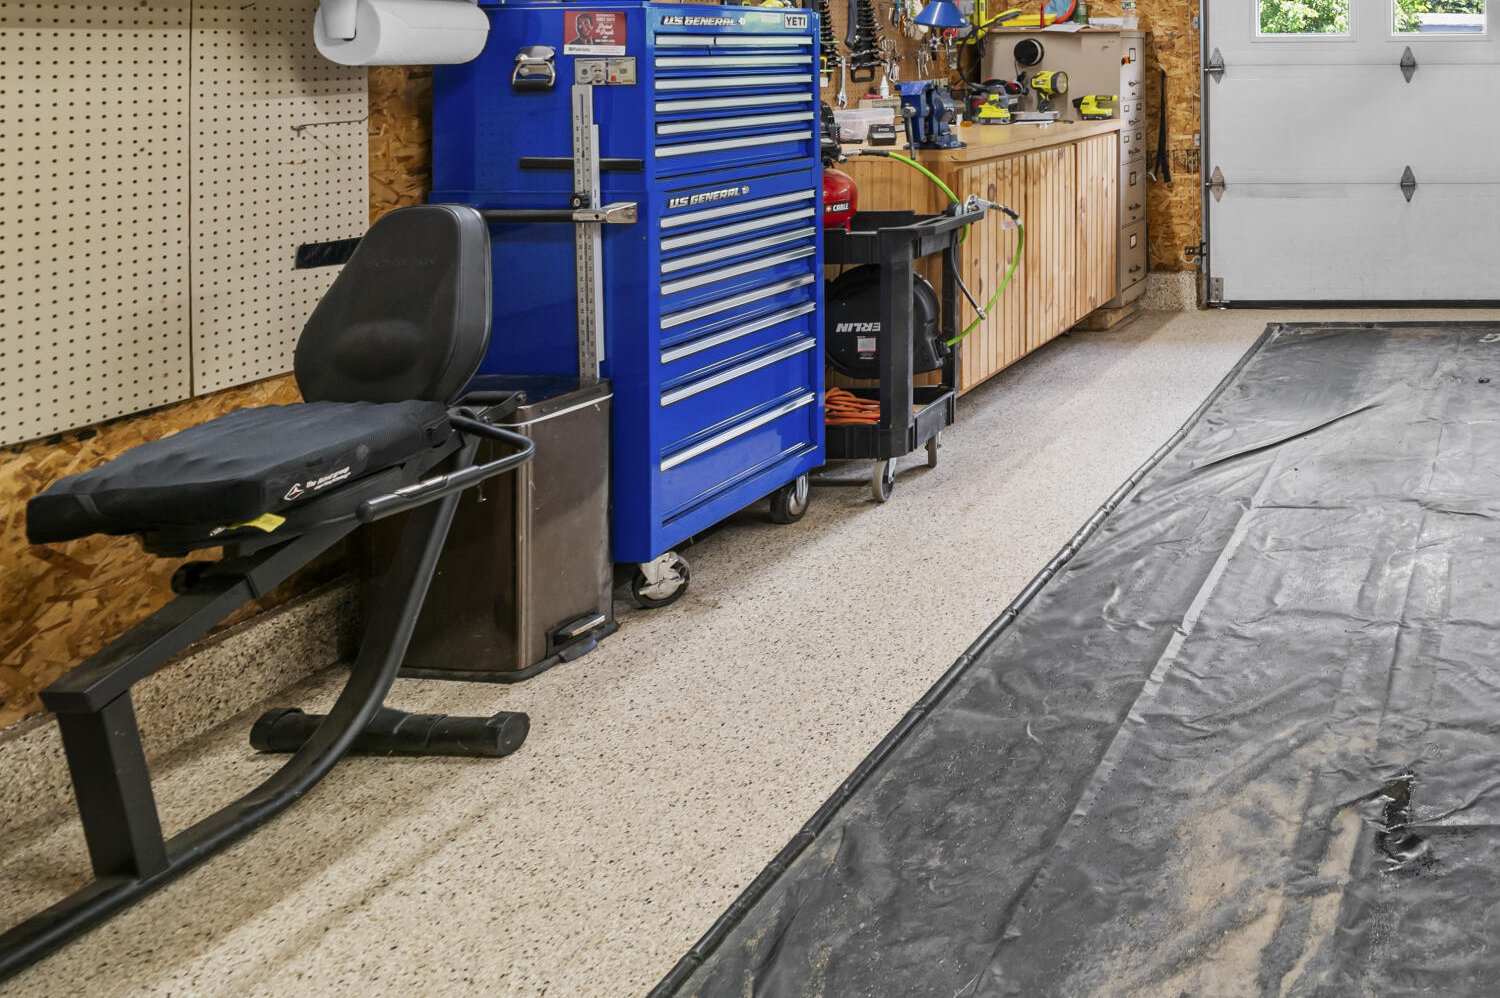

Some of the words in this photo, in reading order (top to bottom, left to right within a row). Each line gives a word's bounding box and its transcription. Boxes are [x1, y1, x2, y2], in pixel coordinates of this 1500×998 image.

[684, 16, 735, 26] GENERAL
[786, 16, 806, 26] YETI
[690, 187, 740, 205] GENERAL
[833, 203, 849, 212] CABLE
[836, 322, 881, 333] ERLIN
